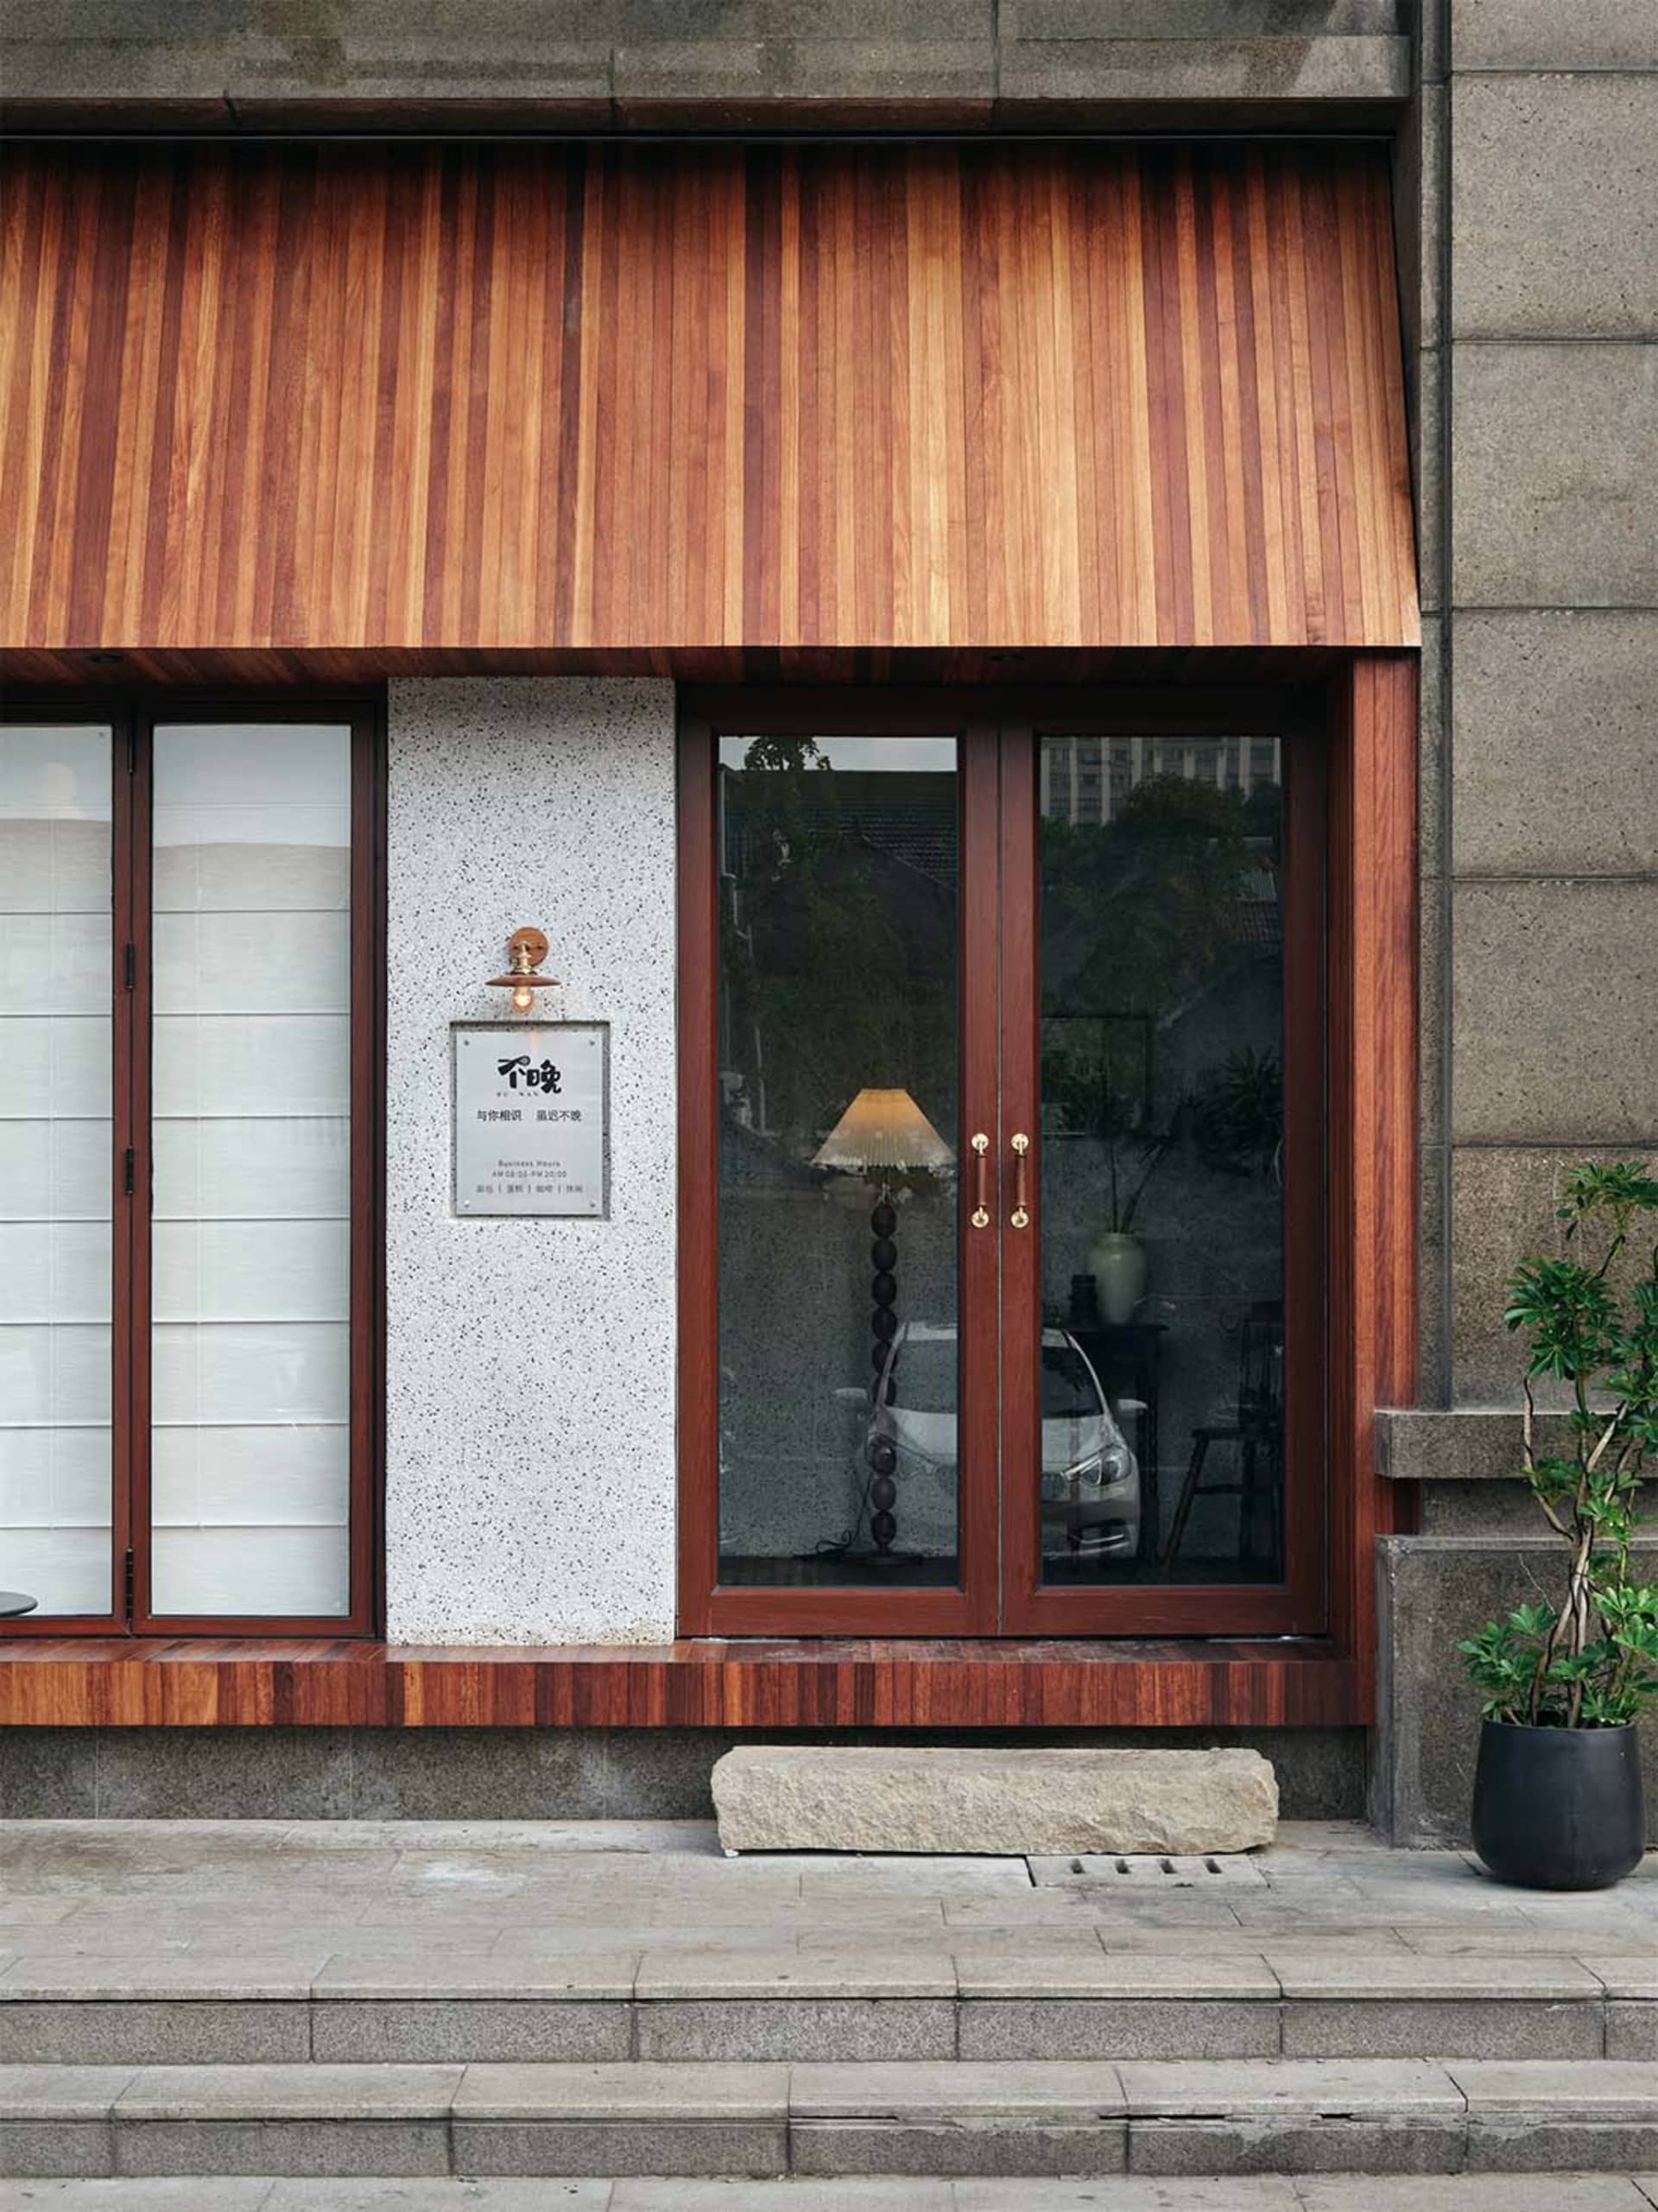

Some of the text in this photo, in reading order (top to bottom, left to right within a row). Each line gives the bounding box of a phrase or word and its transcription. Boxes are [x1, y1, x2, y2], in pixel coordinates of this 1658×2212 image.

[497, 1055, 562, 1094] 不晚
[477, 1109, 582, 1122] 与你相识 虽迟不晚
[497, 1159, 534, 1168] Business
